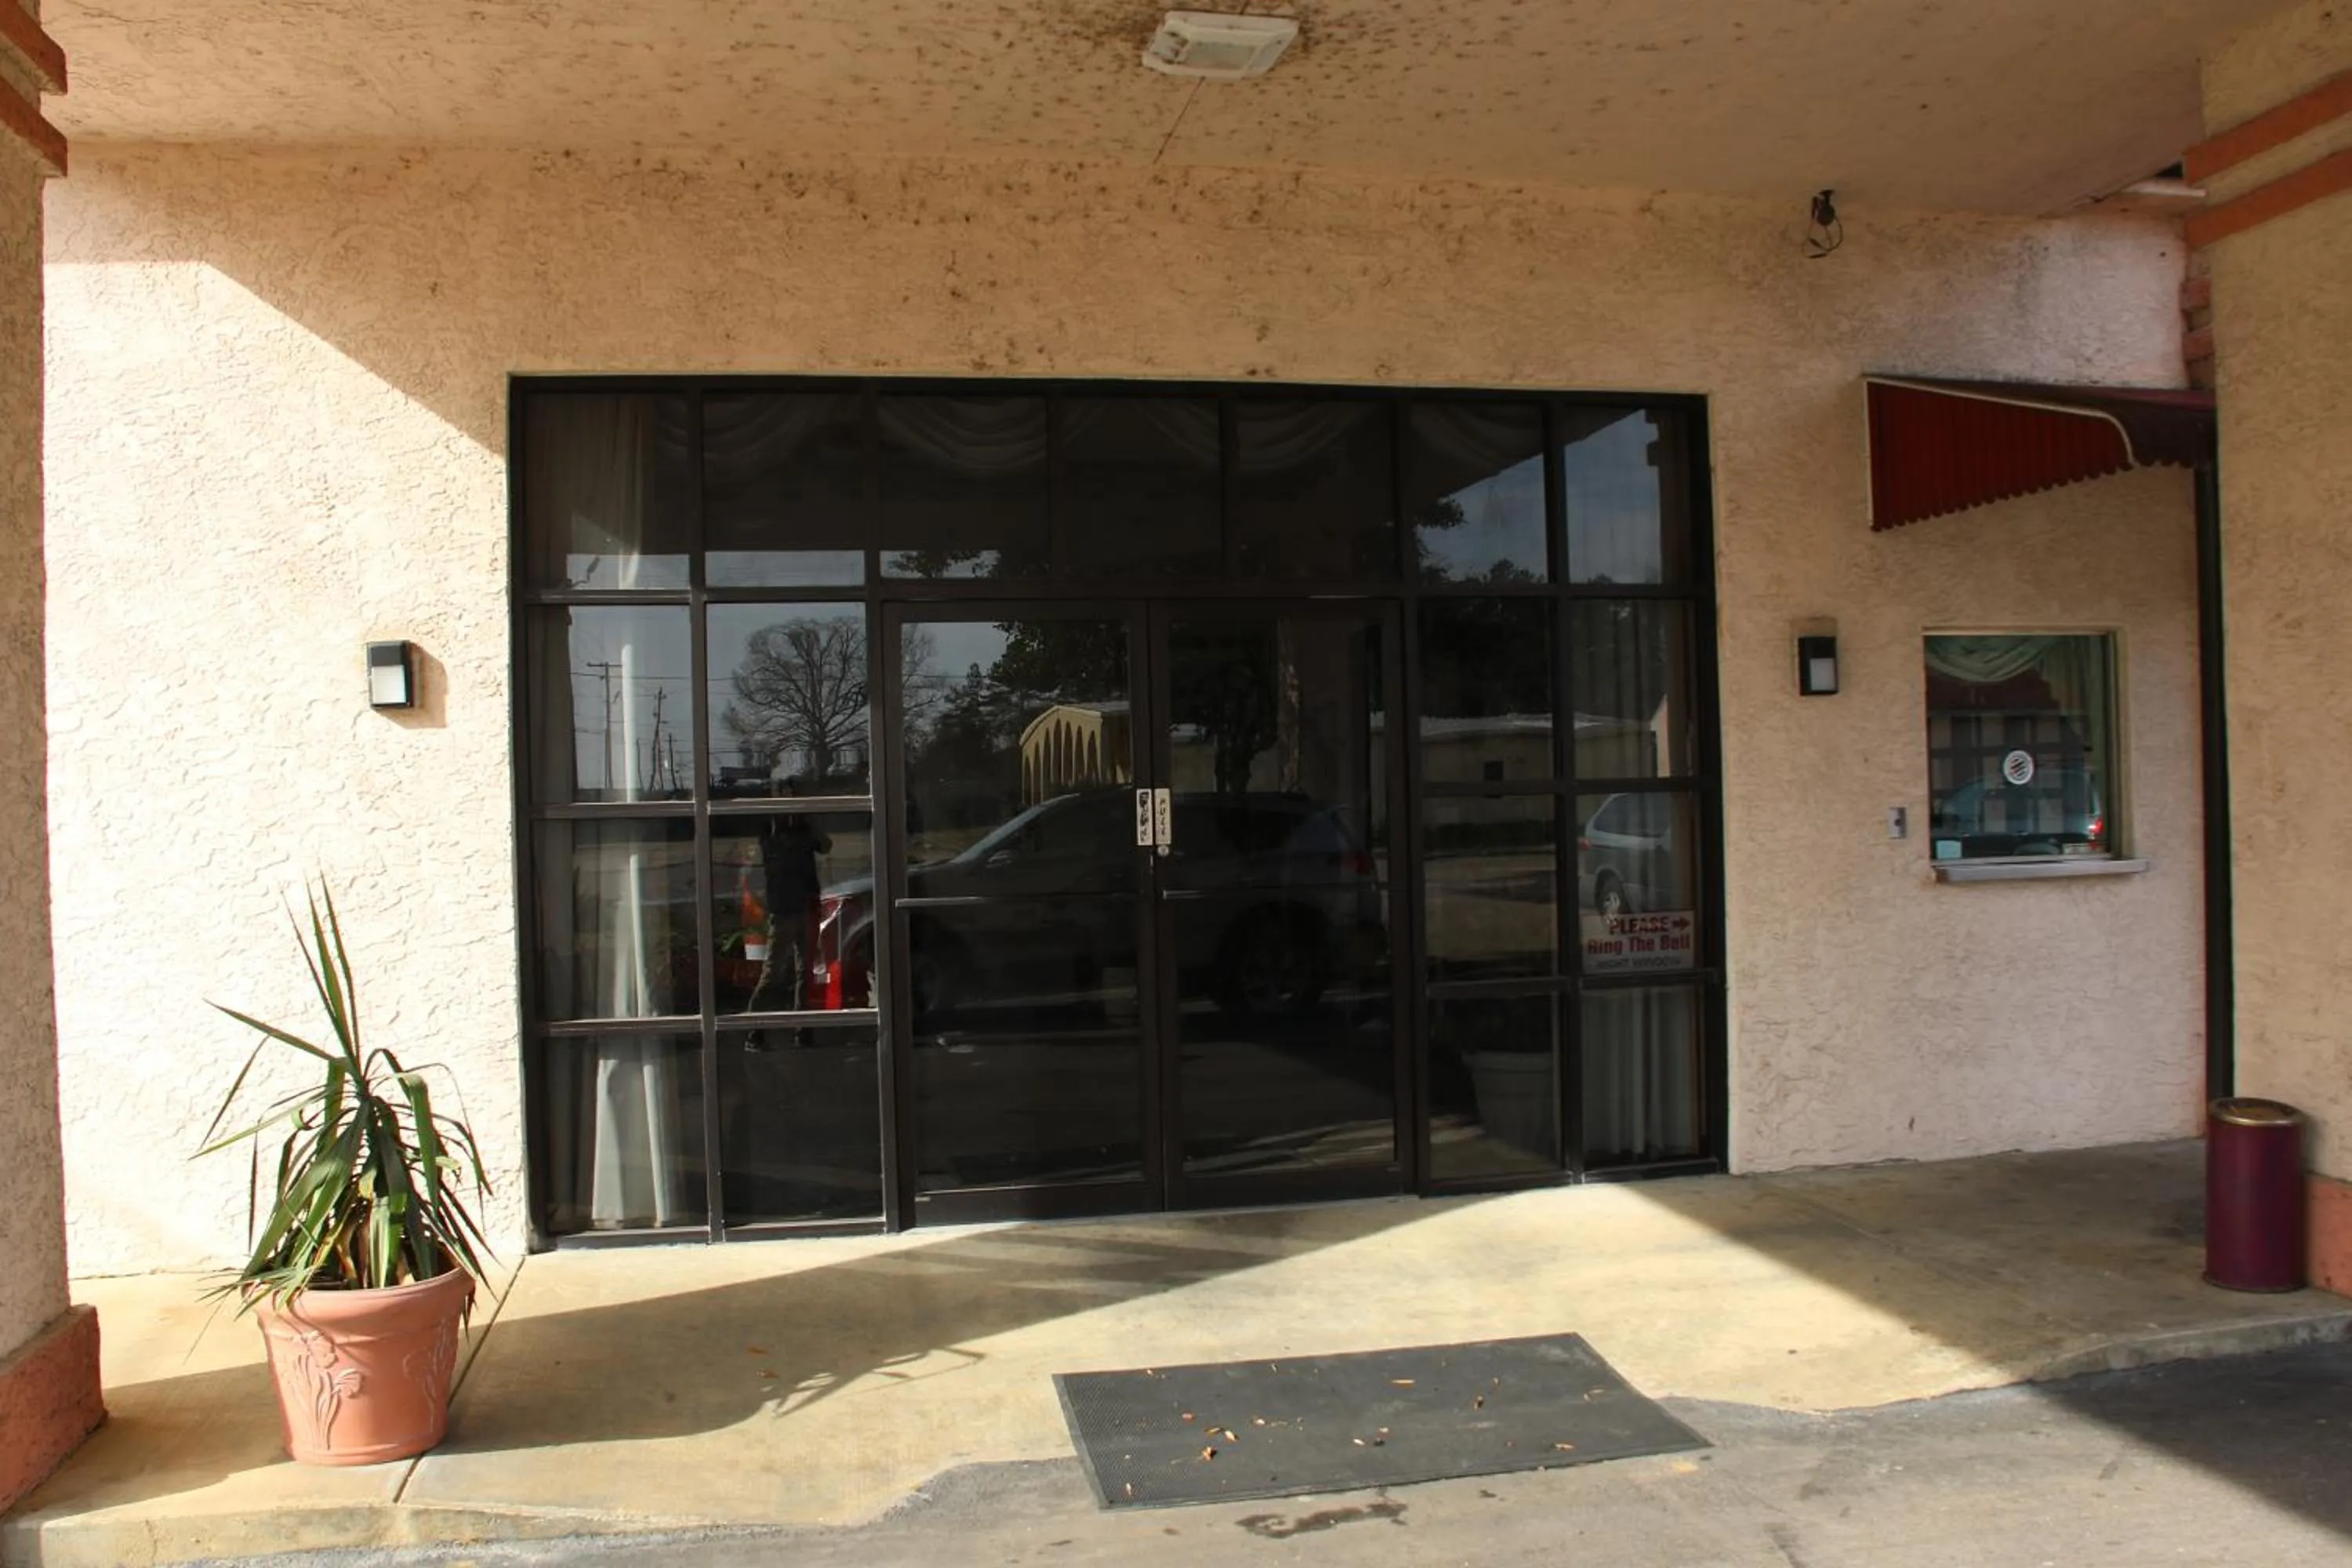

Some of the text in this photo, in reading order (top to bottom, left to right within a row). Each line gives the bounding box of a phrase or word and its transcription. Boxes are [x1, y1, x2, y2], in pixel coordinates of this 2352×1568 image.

[1610, 916, 1669, 935] PLEASE
[1588, 934, 1690, 955] Ring The Bell
